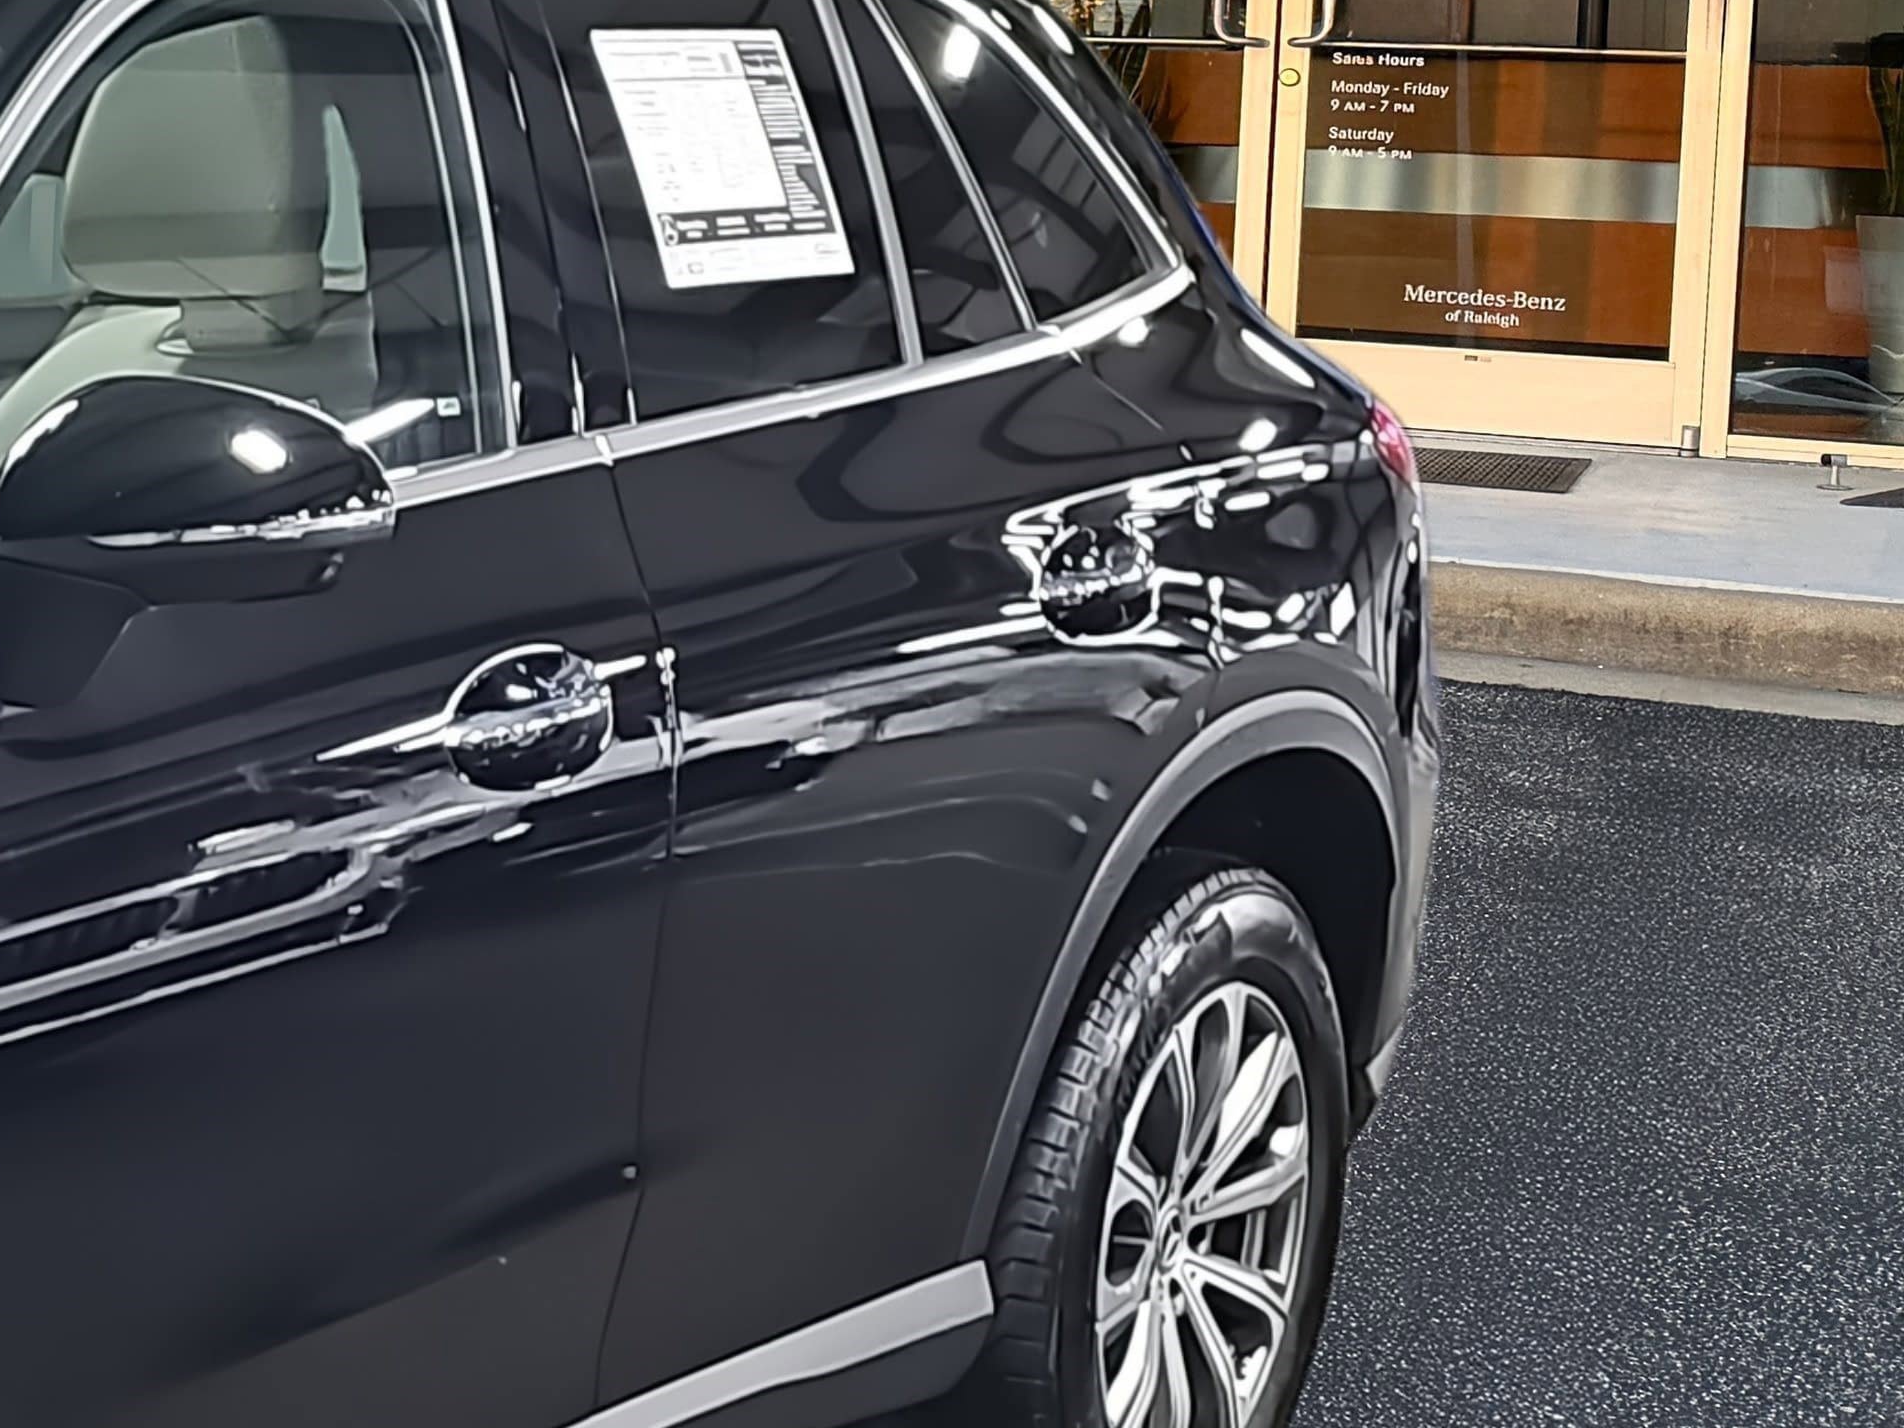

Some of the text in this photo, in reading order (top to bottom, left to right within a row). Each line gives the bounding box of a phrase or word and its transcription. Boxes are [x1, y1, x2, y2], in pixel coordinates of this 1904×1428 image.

[1378, 53, 1425, 67] Hours
[1331, 80, 1391, 98] Monday
[1403, 82, 1450, 99] Friday
[1330, 98, 1340, 112] 9
[1344, 102, 1366, 112] AM
[1379, 100, 1389, 112] 7
[1393, 103, 1415, 113] PM
[1328, 126, 1394, 144] Saturday
[1328, 145, 1338, 157] 9
[1341, 148, 1364, 158] AM
[1377, 147, 1387, 159] 5
[1391, 150, 1412, 160] PM
[1403, 284, 1566, 312] Mercedes-Benz
[1445, 310, 1520, 328] of Raleigh
